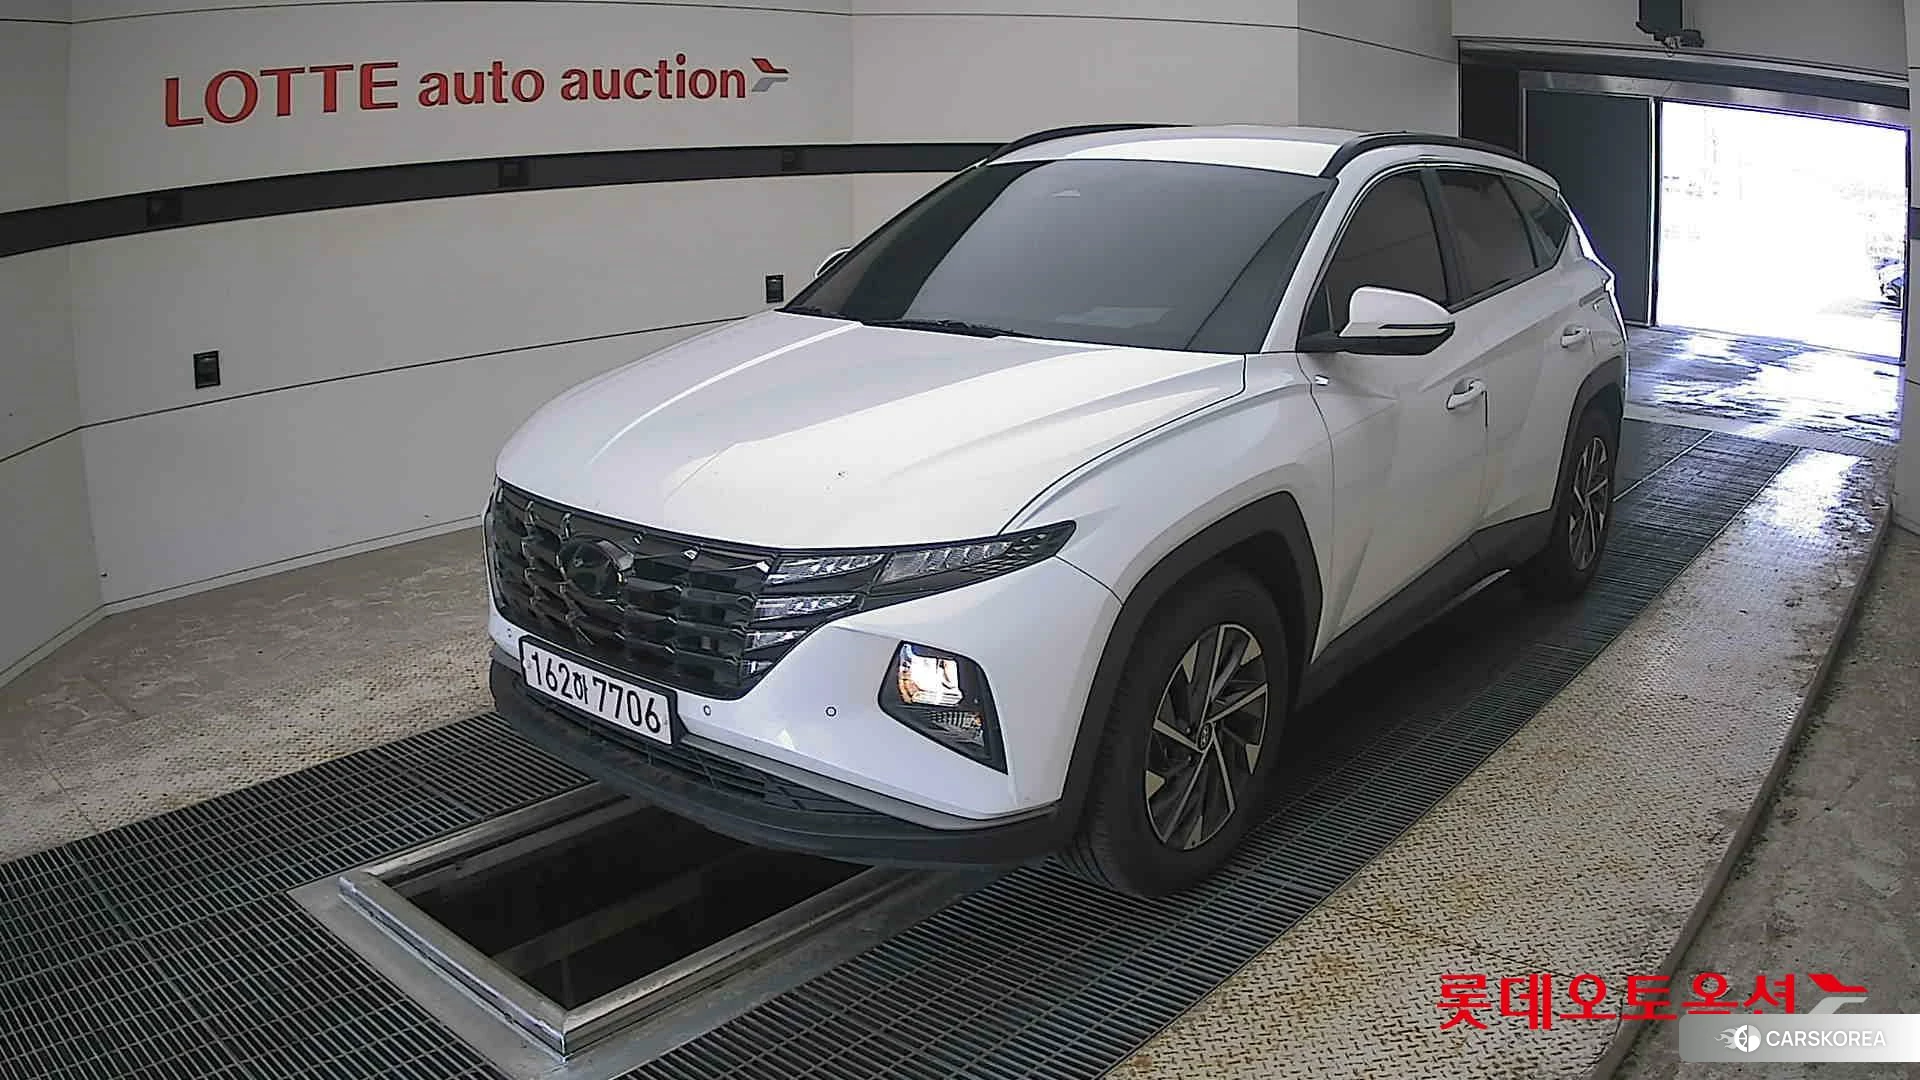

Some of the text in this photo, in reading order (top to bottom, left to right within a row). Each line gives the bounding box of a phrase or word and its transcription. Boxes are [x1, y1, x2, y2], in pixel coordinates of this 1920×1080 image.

[164, 54, 746, 127] LOTTE auto auction
